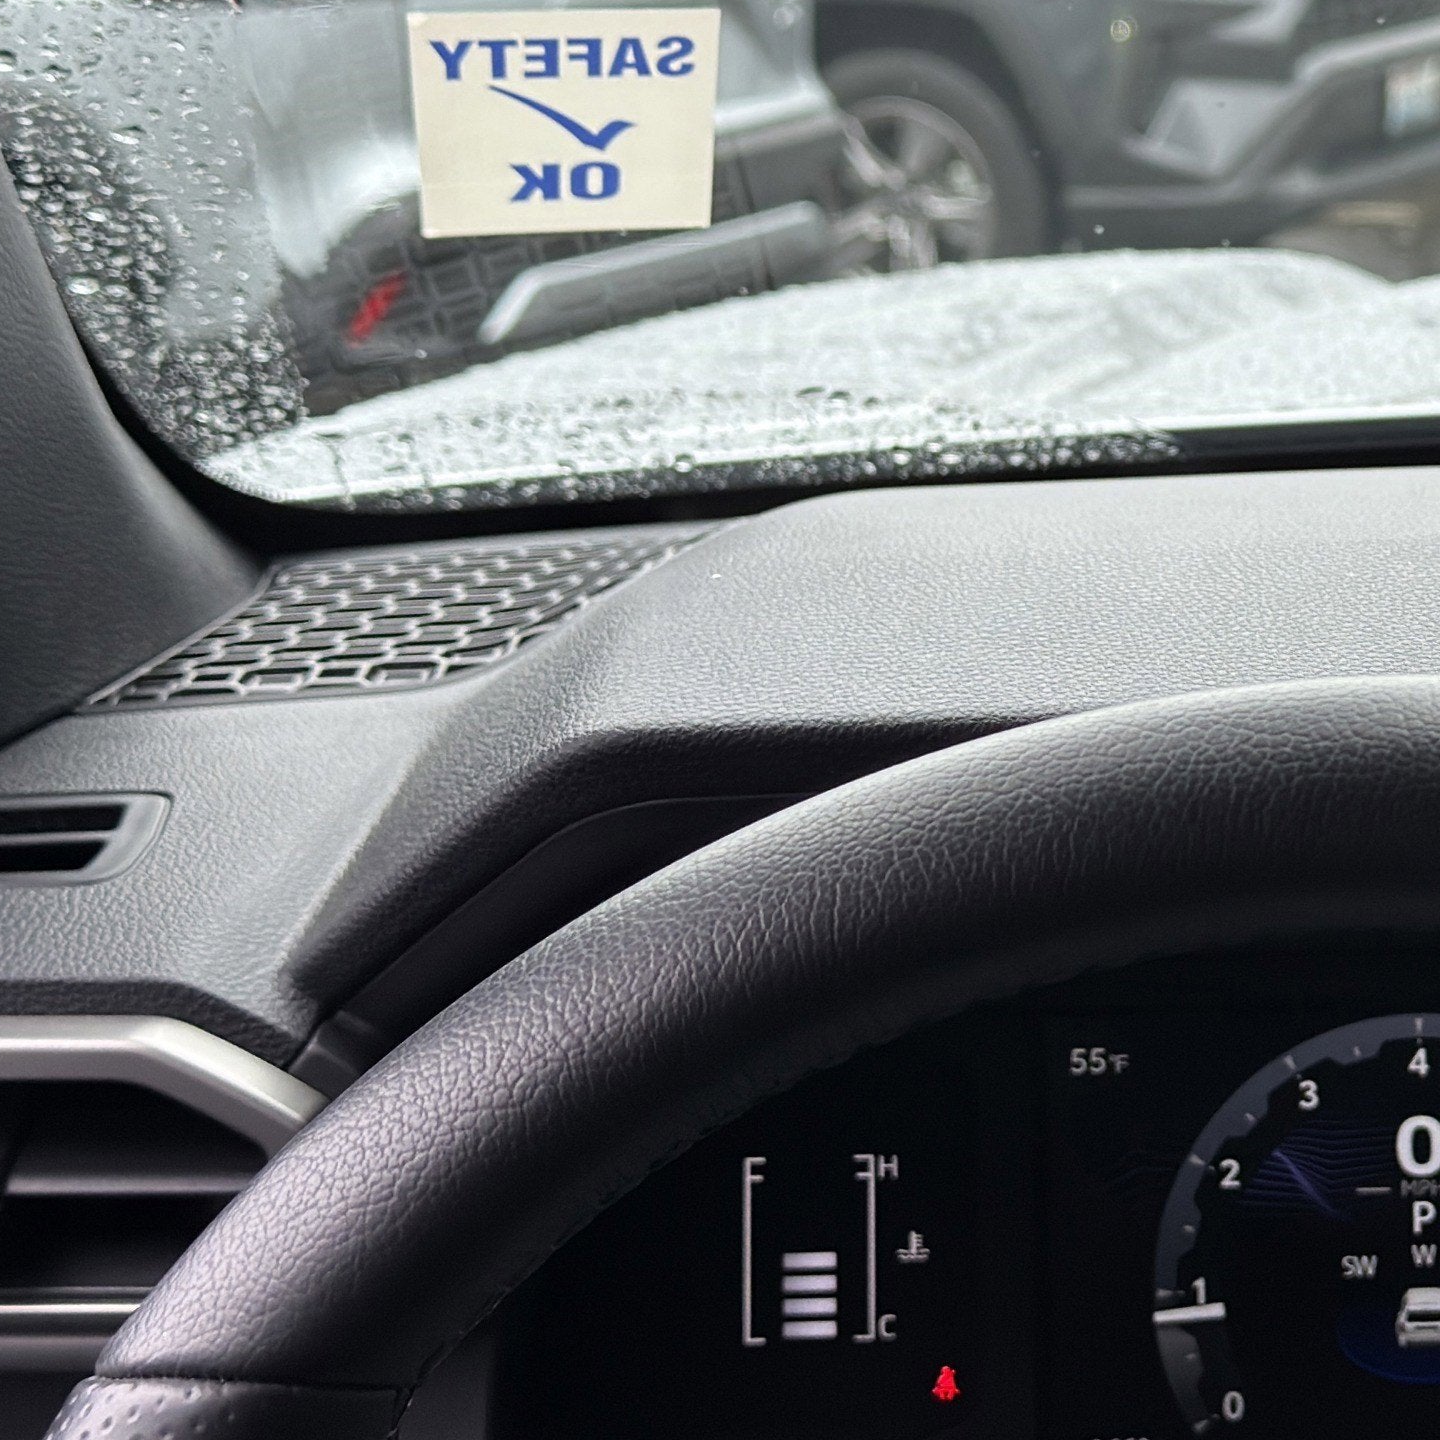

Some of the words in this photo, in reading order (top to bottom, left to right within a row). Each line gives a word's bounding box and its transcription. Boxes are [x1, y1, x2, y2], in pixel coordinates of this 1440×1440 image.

[1407, 1048, 1429, 1078] 4
[1298, 1079, 1320, 1111] 3
[877, 1155, 899, 1181] H
[1219, 1159, 1242, 1189] 2
[1412, 1201, 1438, 1235] P
[1341, 1255, 1378, 1278] SW
[1411, 1243, 1437, 1267] W
[1190, 1277, 1207, 1305] 1
[877, 1313, 897, 1342] C
[1222, 1391, 1245, 1422] 0
